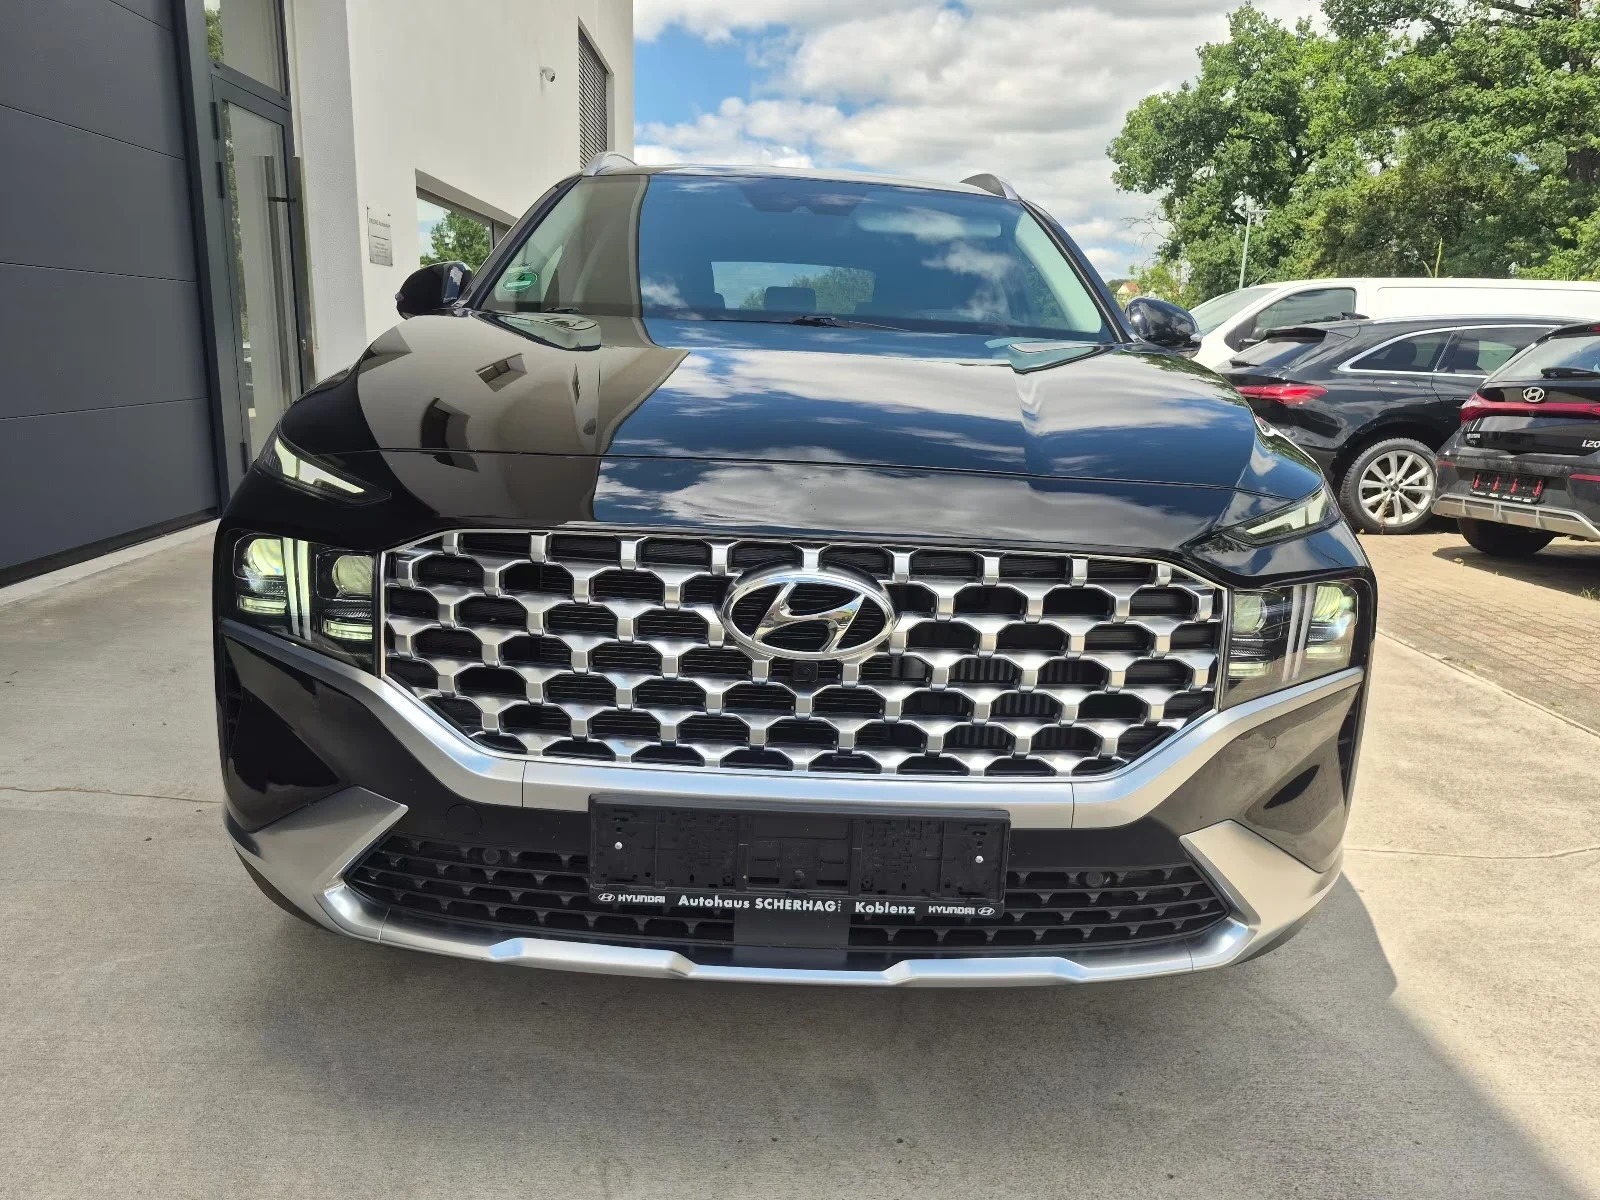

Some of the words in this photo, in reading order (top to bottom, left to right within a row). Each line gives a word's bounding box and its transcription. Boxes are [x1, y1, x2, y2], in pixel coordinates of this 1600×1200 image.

[617, 894, 666, 903] HYUNDAI
[678, 895, 750, 909] Autohaus
[755, 898, 836, 911] SCHERHAG
[855, 901, 915, 915] Koblenz
[928, 905, 975, 915] HYUNDAI
